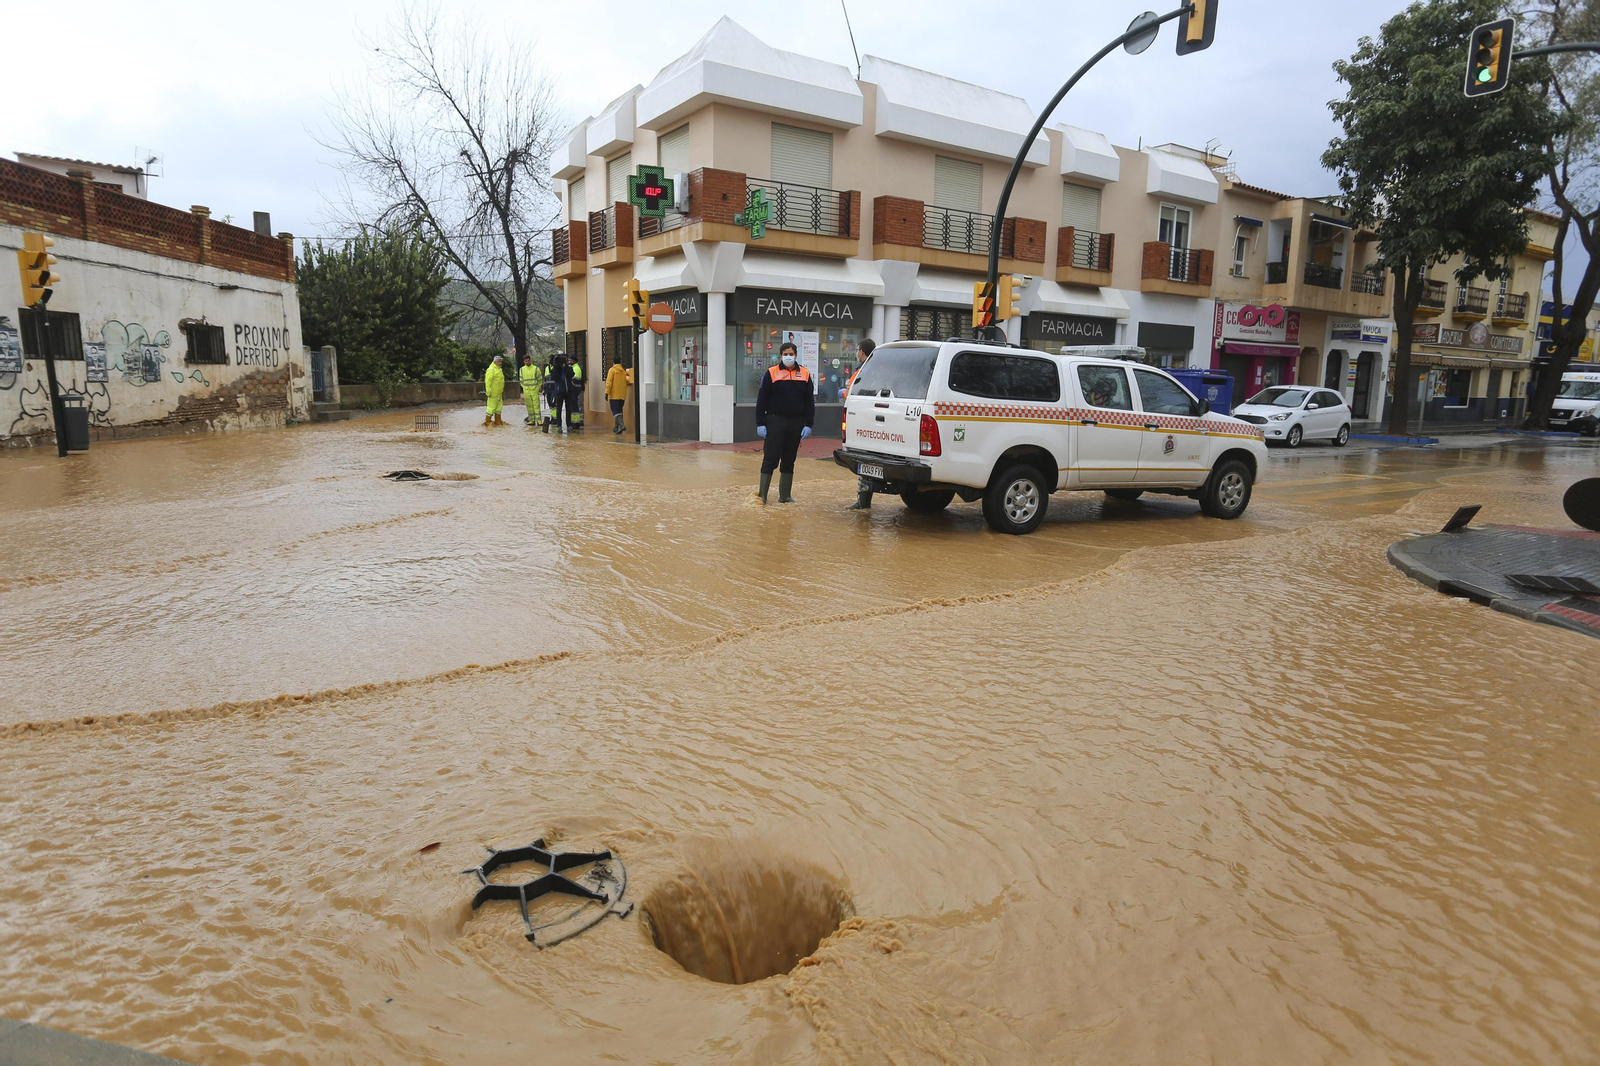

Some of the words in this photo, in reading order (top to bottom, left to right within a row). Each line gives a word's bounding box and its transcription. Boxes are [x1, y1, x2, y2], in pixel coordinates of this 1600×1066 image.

[756, 297, 854, 320] FARMACIA
[234, 323, 290, 351] PROXIMO
[1041, 319, 1103, 338] FARMACIA
[236, 345, 279, 368] DERRIBO
[905, 405, 922, 417] L-10
[856, 428, 890, 442] PROTECCIÓN
[890, 433, 905, 443] CIVIL
